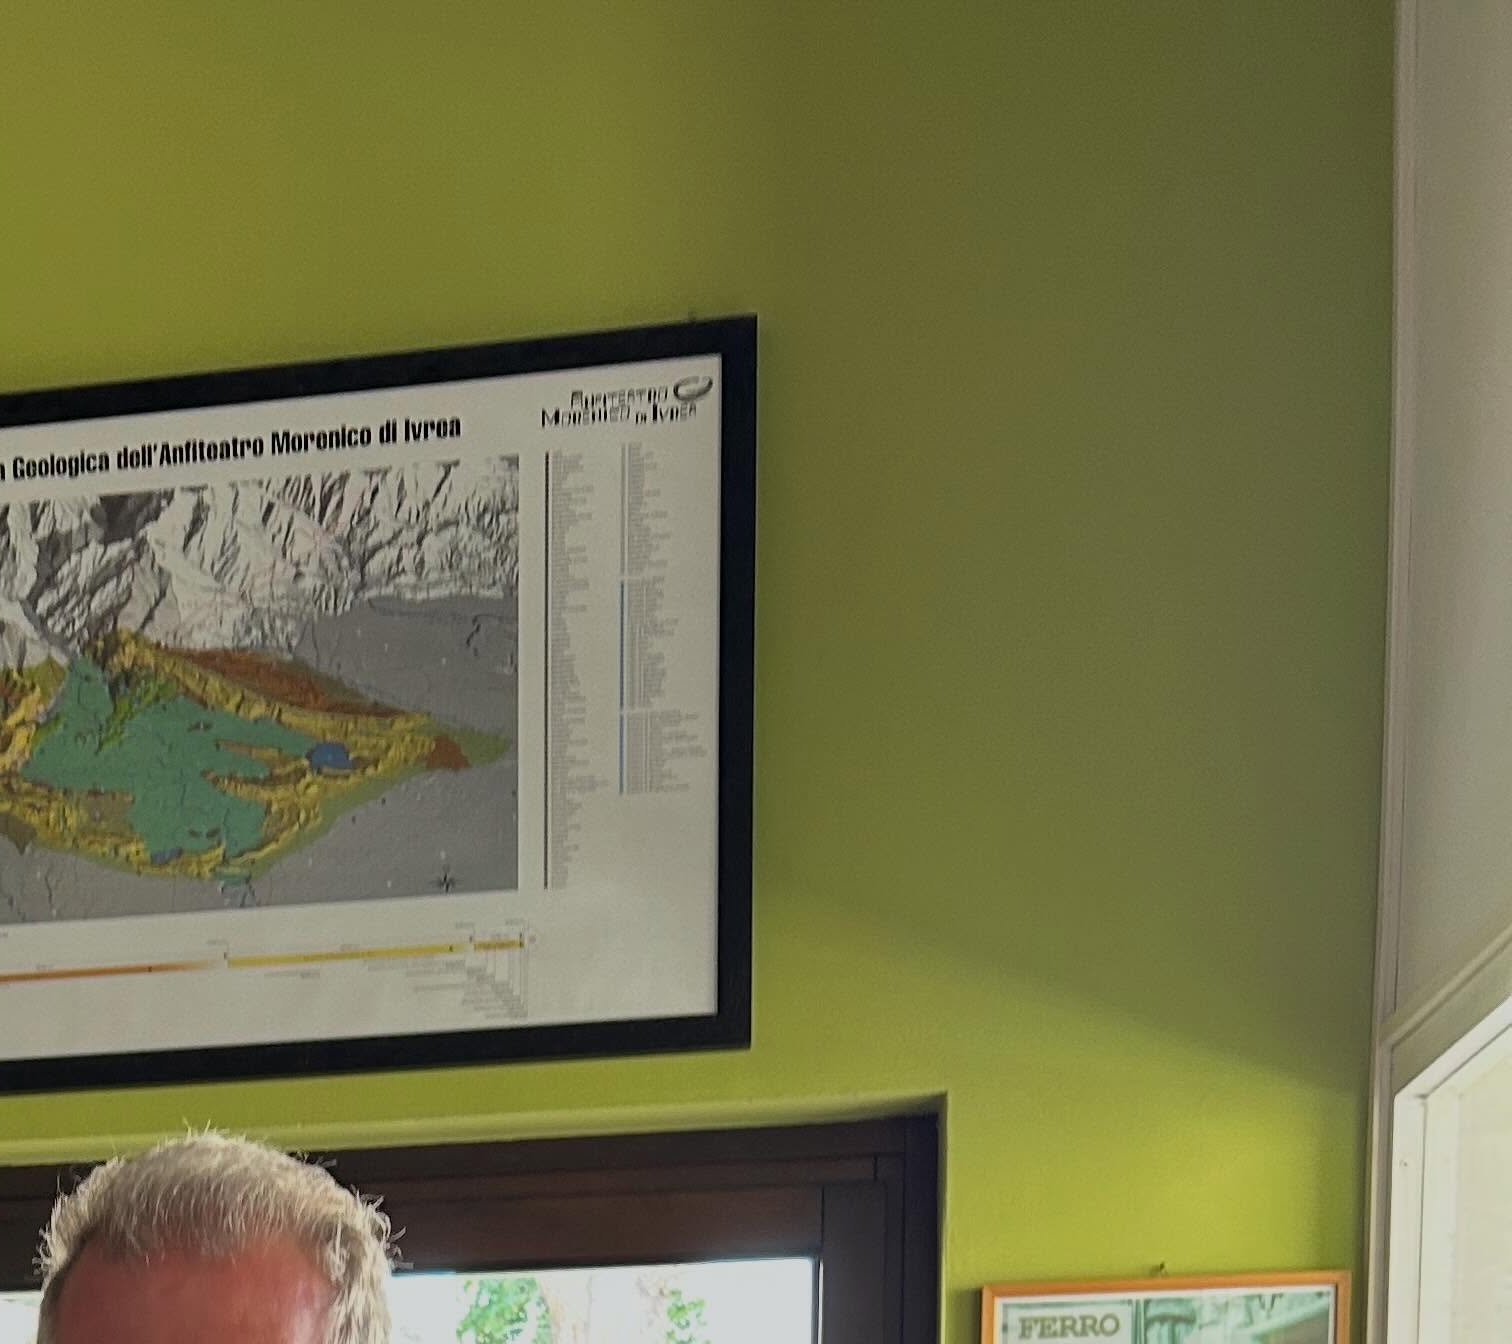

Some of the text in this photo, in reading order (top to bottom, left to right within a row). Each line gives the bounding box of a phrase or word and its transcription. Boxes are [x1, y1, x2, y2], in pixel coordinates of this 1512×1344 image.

[12, 455, 110, 482] Geologica
[116, 433, 265, 471] dell'Anfiteatro
[271, 428, 373, 456] Morenico
[379, 418, 398, 446] di
[404, 416, 462, 443] Ivrea
[1018, 1313, 1120, 1340] FERRO
